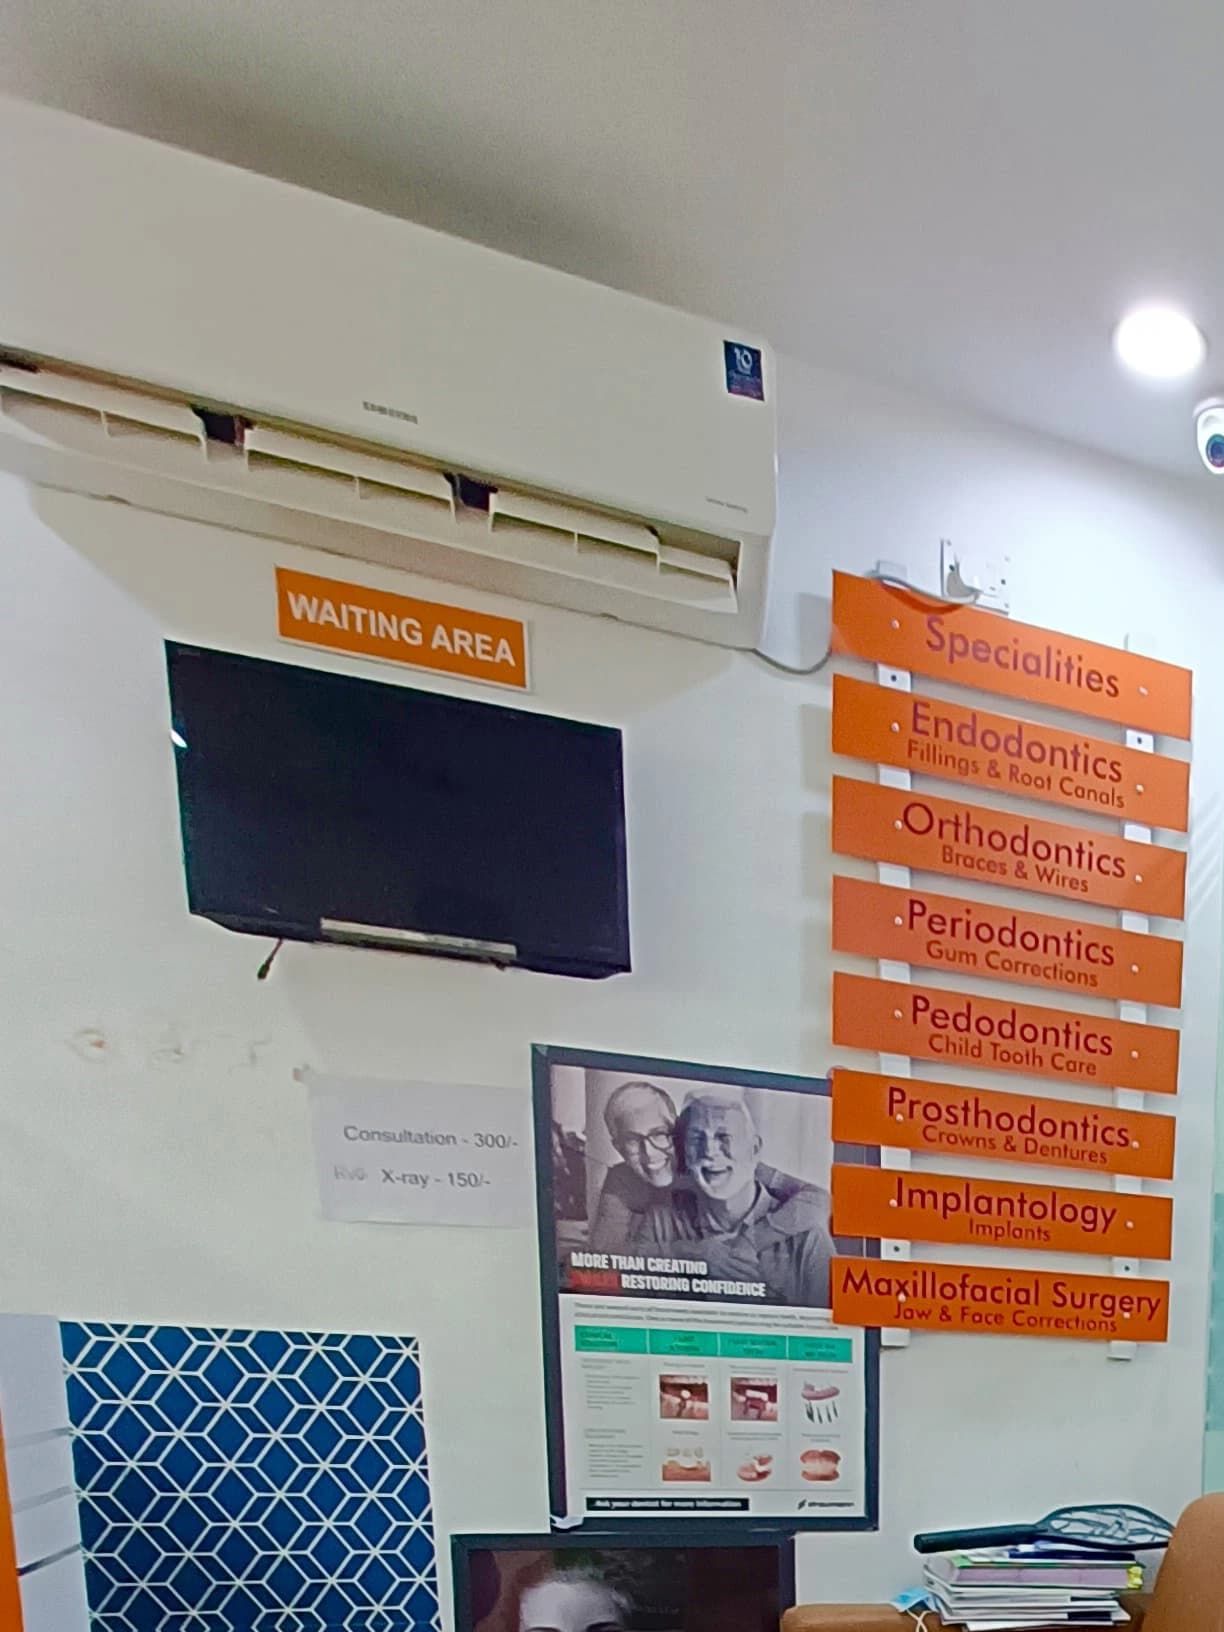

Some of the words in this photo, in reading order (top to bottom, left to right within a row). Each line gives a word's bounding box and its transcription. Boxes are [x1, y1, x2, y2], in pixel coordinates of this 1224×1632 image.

[288, 591, 423, 645] WAITING
[431, 624, 516, 667] AREA
[926, 616, 1120, 698] Specialities
[912, 702, 1122, 782] Endodontics
[907, 740, 980, 777] Fillings
[987, 763, 1000, 779] &
[1009, 768, 1052, 791] Root
[1059, 777, 1125, 809] Canals
[903, 802, 1126, 879] Orthodontics
[942, 846, 1007, 876] Braces
[1014, 861, 1028, 880] &
[1036, 865, 1088, 893] Wires
[908, 899, 1114, 966] Periodontics
[926, 940, 978, 965] Gum
[985, 950, 1098, 987] Corrections
[912, 995, 1113, 1056] Pedodontics
[928, 1034, 982, 1060] Child
[990, 1043, 1043, 1068] Tooth
[1051, 1053, 1097, 1076] Care
[343, 1125, 458, 1146] Consultation
[474, 1133, 519, 1149] 300/-
[888, 1086, 1130, 1148] Prosthodontics
[922, 1125, 996, 1151] Crowns
[1003, 1136, 1017, 1152] &
[1024, 1140, 1107, 1165] Dentures
[381, 1168, 430, 1190] X-ray
[448, 1172, 491, 1188] 150/-
[896, 1177, 1117, 1233] Implantology
[968, 1219, 1051, 1243] Implants
[571, 1252, 609, 1269] MORE
[611, 1255, 645, 1271] THAN
[647, 1258, 708, 1275] CREATING
[621, 1274, 690, 1292] RESTORING
[692, 1279, 767, 1297] CONFIDENCE
[842, 1267, 1040, 1306] Maxillofacial
[1052, 1281, 1161, 1321] Surgery
[939, 1305, 952, 1322] &
[961, 1306, 1004, 1326] Face
[1012, 1312, 1118, 1334] Corrections
